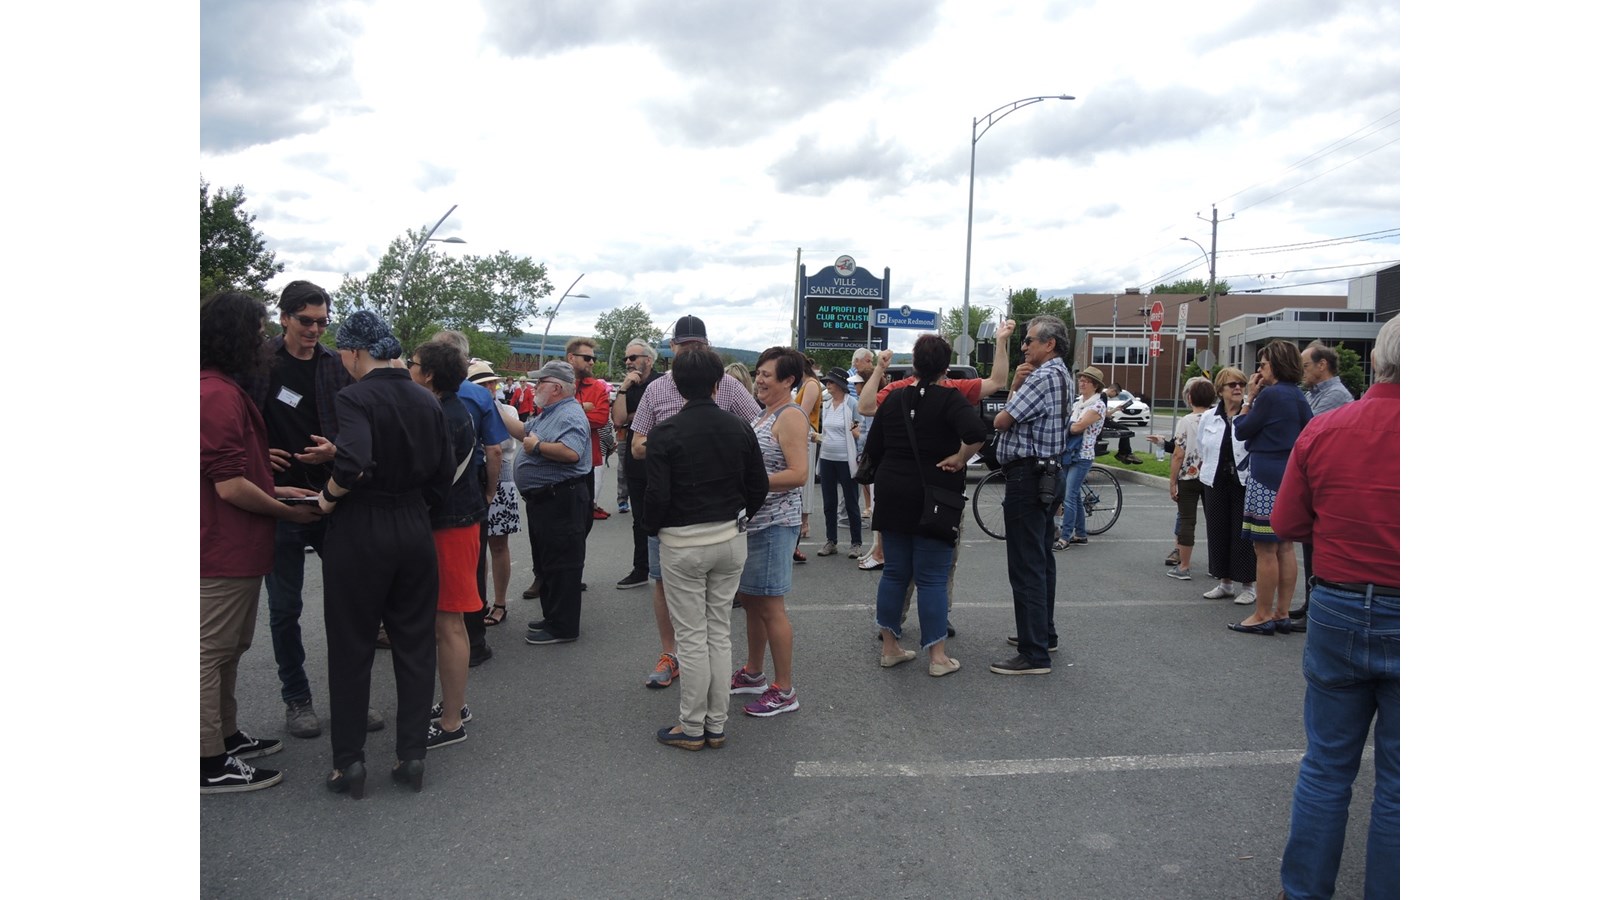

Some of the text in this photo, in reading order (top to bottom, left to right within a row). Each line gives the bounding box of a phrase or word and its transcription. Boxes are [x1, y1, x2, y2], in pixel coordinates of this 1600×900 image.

[834, 278, 856, 286] VILLE
[810, 286, 879, 296] SAINT-GEORGES
[888, 316, 906, 325] Espace
[986, 403, 1006, 411] FIE
